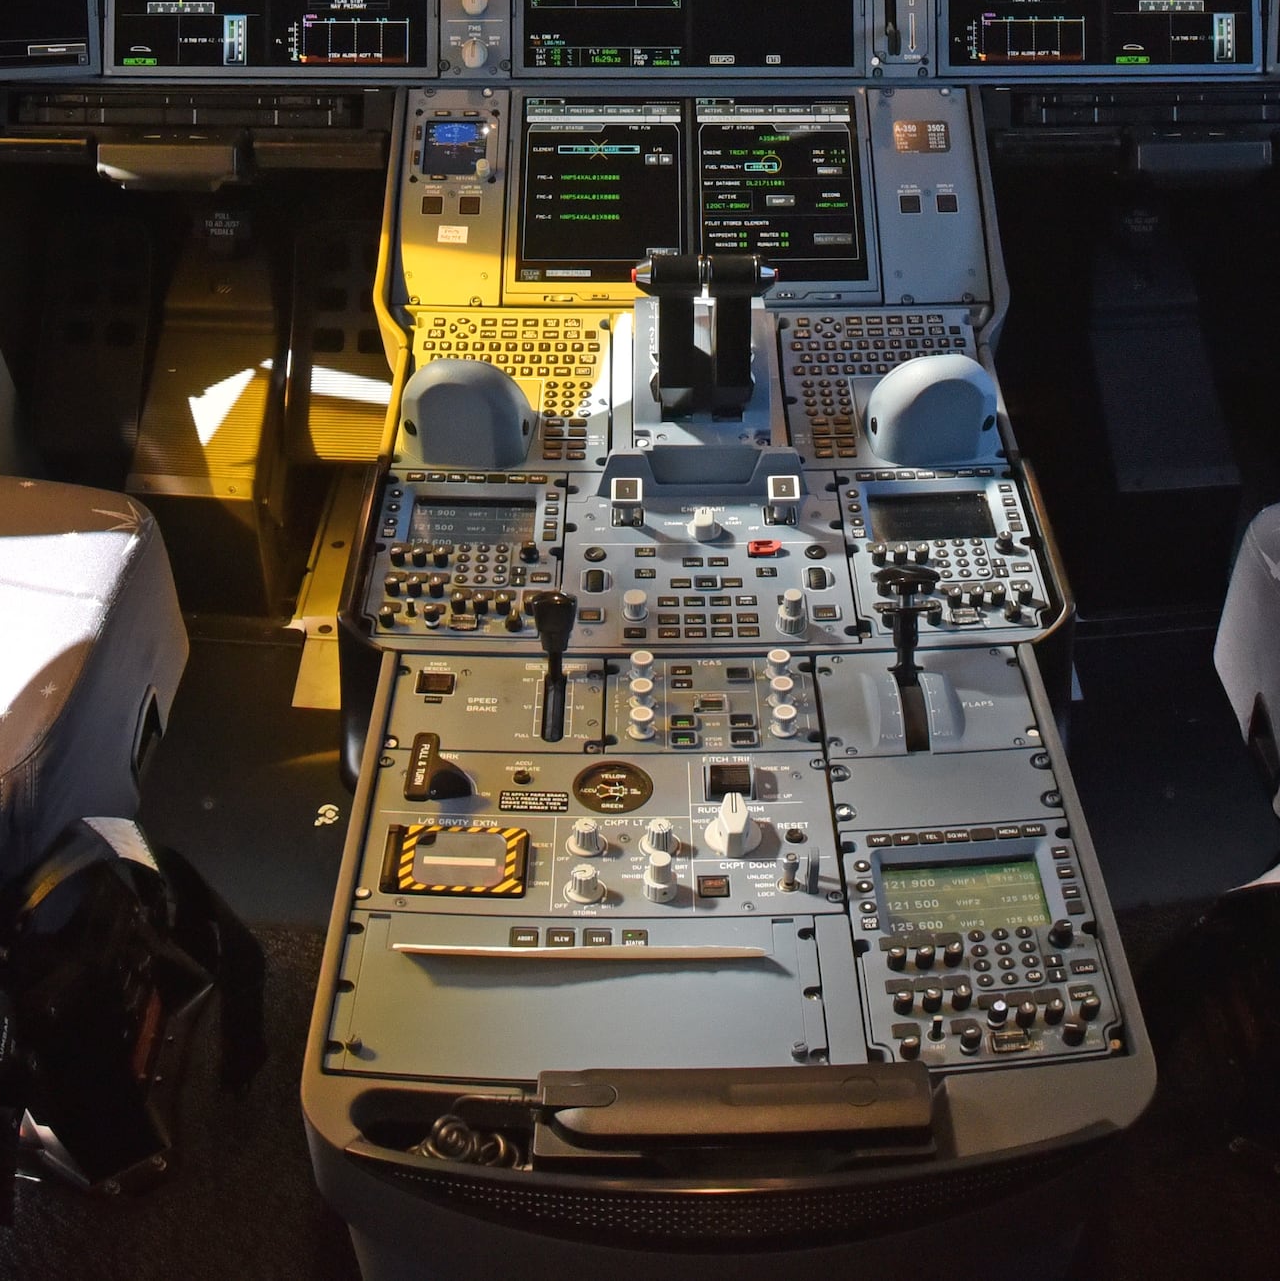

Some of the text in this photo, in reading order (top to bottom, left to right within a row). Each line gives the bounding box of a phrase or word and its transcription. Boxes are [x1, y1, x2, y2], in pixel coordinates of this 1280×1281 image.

[894, 124, 946, 134] A-350 3502
[728, 149, 749, 157] TRENT
[696, 659, 723, 667] TCAS
[467, 697, 499, 705] SPEED
[962, 700, 995, 709] FLAPS
[465, 705, 499, 713] BRAKE
[419, 743, 431, 761] PULL
[413, 767, 426, 786] TURN
[417, 817, 499, 828] L/G GRVTY EXTN
[604, 819, 645, 827] CKPT LT
[776, 821, 810, 831] RESET
[998, 828, 1019, 836] MENU
[1025, 825, 1042, 833] NAV
[946, 831, 970, 840] SQWK
[872, 836, 887, 844] VHF
[719, 860, 778, 871] CKPT DOOR
[746, 873, 775, 881] UNLOCK
[754, 881, 775, 889] NORM
[951, 877, 977, 887] VHF1
[756, 890, 776, 898] LOCK
[955, 897, 981, 907] VHF2
[959, 918, 986, 929] VHF3
[516, 935, 535, 943] ABORT
[553, 935, 570, 943] SLEW
[592, 935, 607, 943] TEST
[1075, 964, 1094, 973] LOAD
